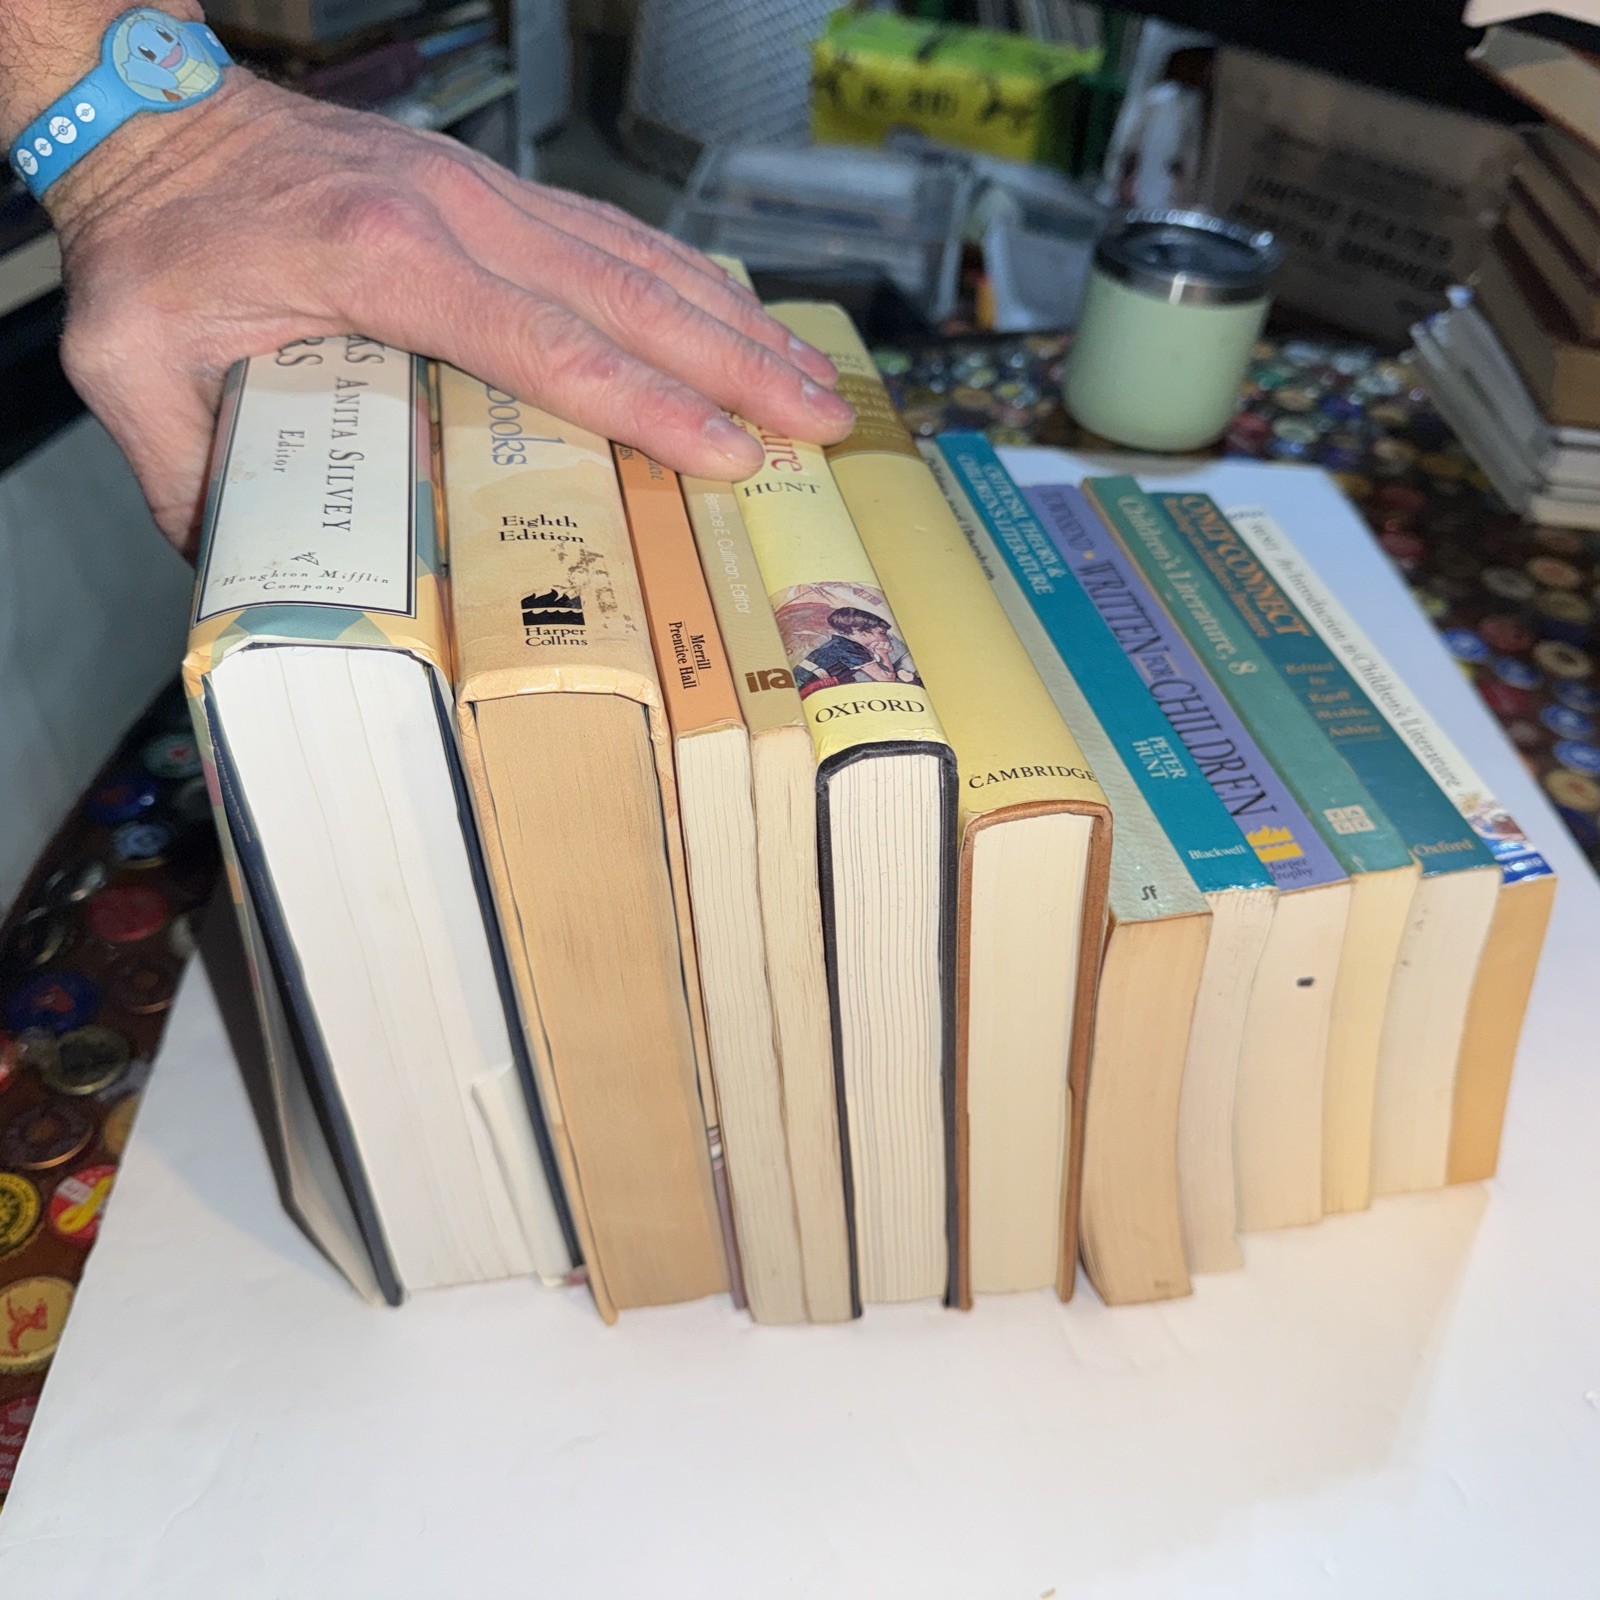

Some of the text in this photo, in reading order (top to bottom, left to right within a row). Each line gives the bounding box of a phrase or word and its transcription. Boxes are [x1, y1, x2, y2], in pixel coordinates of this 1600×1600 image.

[331, 377, 369, 440] ANITA
[274, 429, 305, 473] Editor
[322, 449, 365, 532] SILVEY
[743, 481, 820, 498] HUNT
[501, 514, 579, 529] Eighth
[499, 529, 584, 544] Edition
[222, 569, 389, 587] Houghton Mifflin
[262, 580, 345, 593] Company
[731, 584, 751, 615] Editor
[524, 626, 586, 638] Harper
[525, 636, 588, 647] Collins
[669, 621, 697, 689] Prentice Hall
[690, 634, 711, 670] Merrill
[744, 667, 795, 693] ira
[1078, 558, 1171, 655] WRITTEN
[1150, 678, 1277, 816] CHILDREN
[815, 699, 925, 723] OXFORD
[1132, 740, 1169, 779] HUNT
[1147, 735, 1188, 779] PETER
[968, 765, 1098, 789] CAMBRIDGE
[1188, 844, 1247, 860] Blackwell
